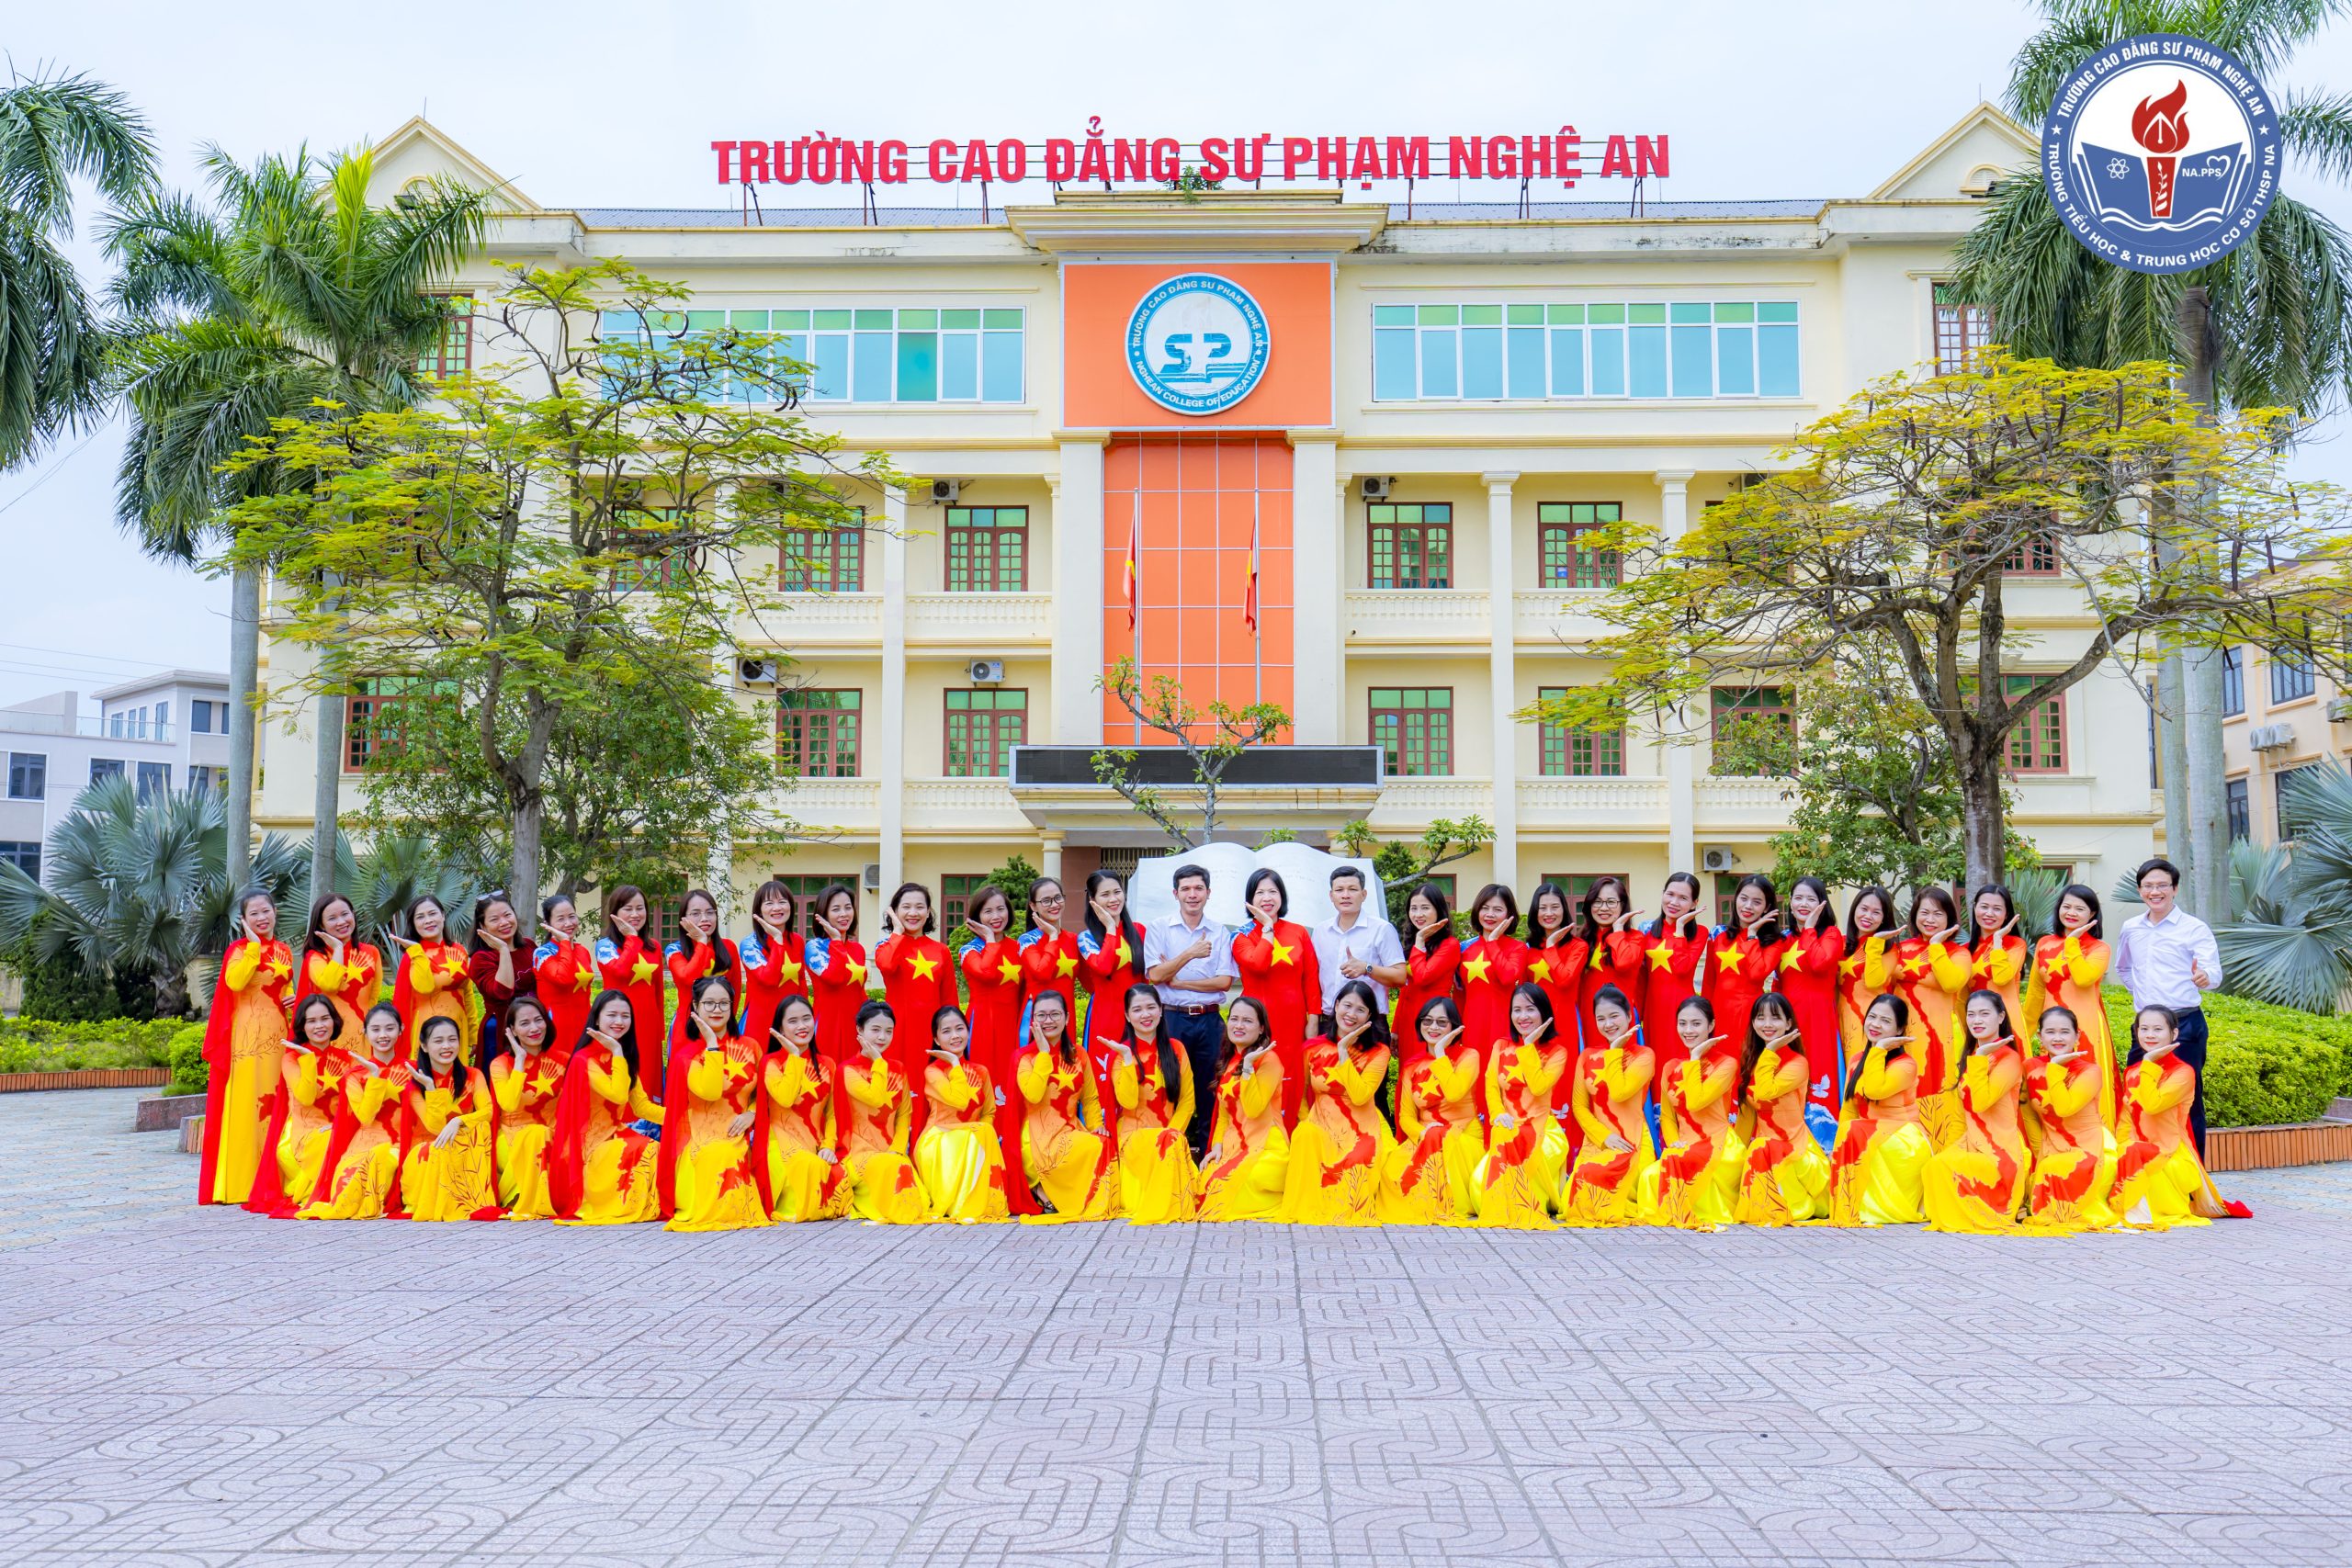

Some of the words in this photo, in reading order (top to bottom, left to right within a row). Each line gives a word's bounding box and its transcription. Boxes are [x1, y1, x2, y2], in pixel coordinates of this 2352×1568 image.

[711, 130, 908, 185] TRƯỜNG
[929, 139, 1027, 184] CAO
[1044, 116, 1181, 183] ĐẲNG
[1199, 133, 1272, 182] SƯ
[1283, 136, 1430, 191] PHẠM
[1449, 126, 1582, 189] NGHỆ
[1600, 135, 1669, 179] AN
[1132, 308, 1150, 348] TRƯỜNG
[1148, 291, 1168, 309] CAO
[1200, 280, 1216, 289] SƯ
[1216, 284, 1245, 305] PHẠM
[1242, 303, 1262, 331] NGHỆ
[1254, 332, 1263, 347] AN
[1136, 360, 1165, 395] NGHEAN
[1162, 391, 1204, 408] COLLEGE
[1205, 397, 1219, 407] OF
[1219, 359, 1261, 403] EDUCATION
